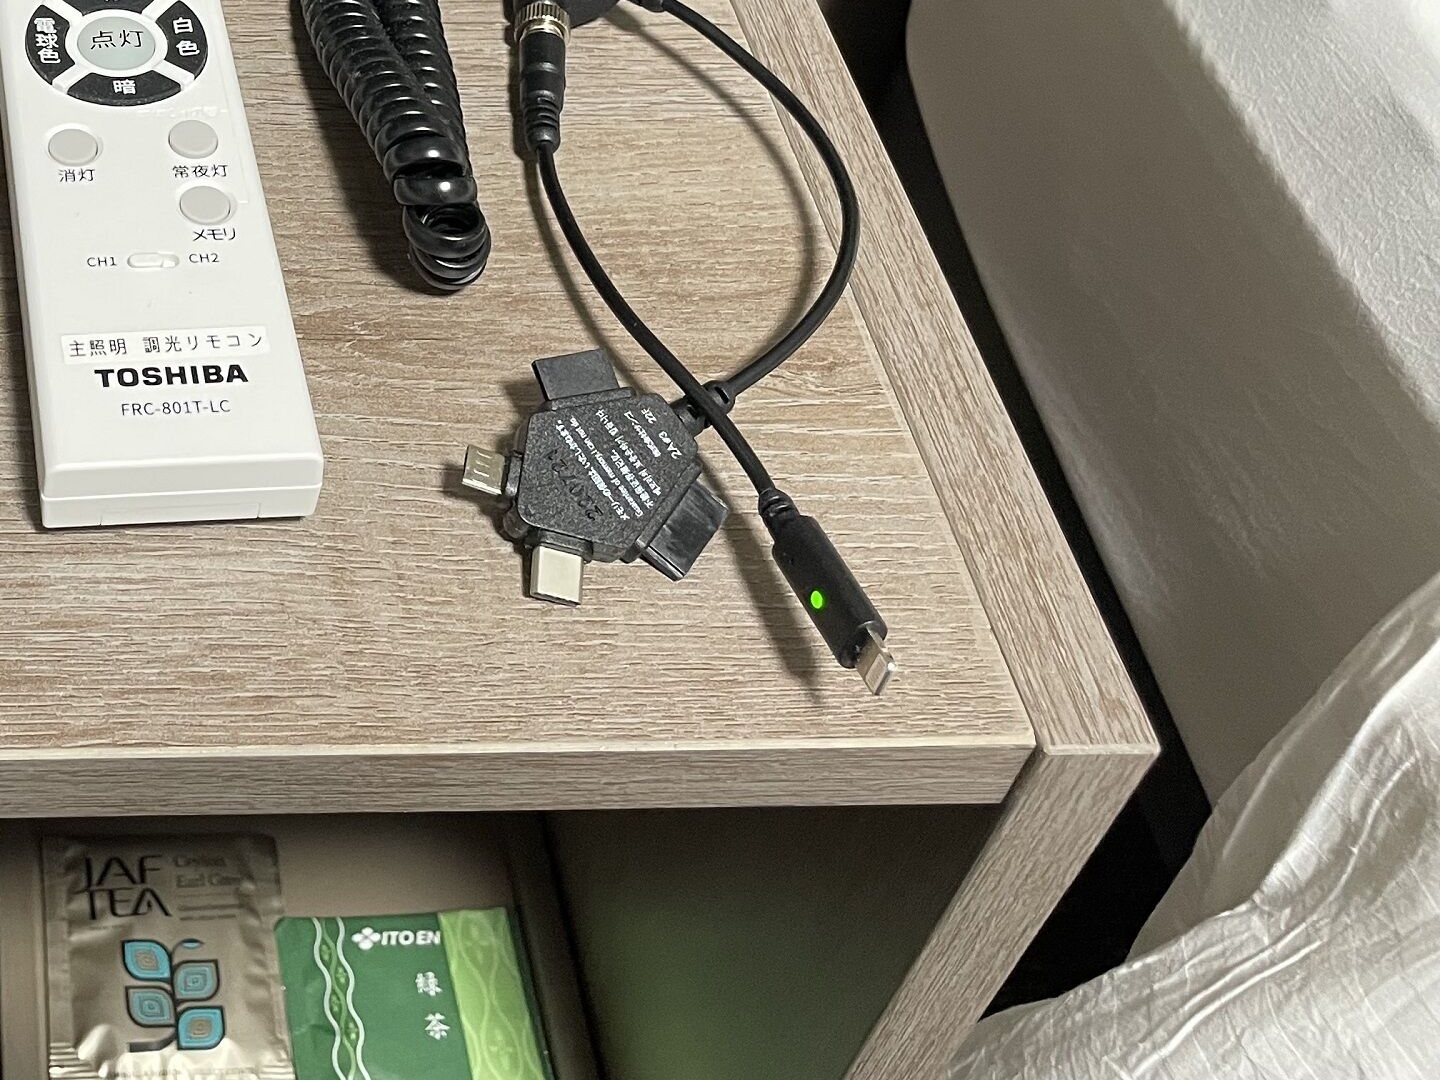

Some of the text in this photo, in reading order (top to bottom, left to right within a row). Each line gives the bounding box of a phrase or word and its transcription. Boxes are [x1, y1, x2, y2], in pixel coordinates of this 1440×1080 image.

[33, 17, 61, 64] 電球色
[90, 29, 145, 50] 点灯
[172, 16, 201, 57] 白色
[112, 79, 137, 95] 暗
[58, 168, 95, 183] 消灯
[172, 164, 228, 178] 常夜灯
[192, 227, 236, 241] メモリ
[87, 256, 117, 267] CH1
[189, 253, 220, 264] CH2
[68, 332, 262, 357] 主照明 調光リモコン
[94, 364, 248, 388] TOSHIBA
[121, 399, 231, 416] FRC-801T-LC
[74, 886, 172, 920] TEA
